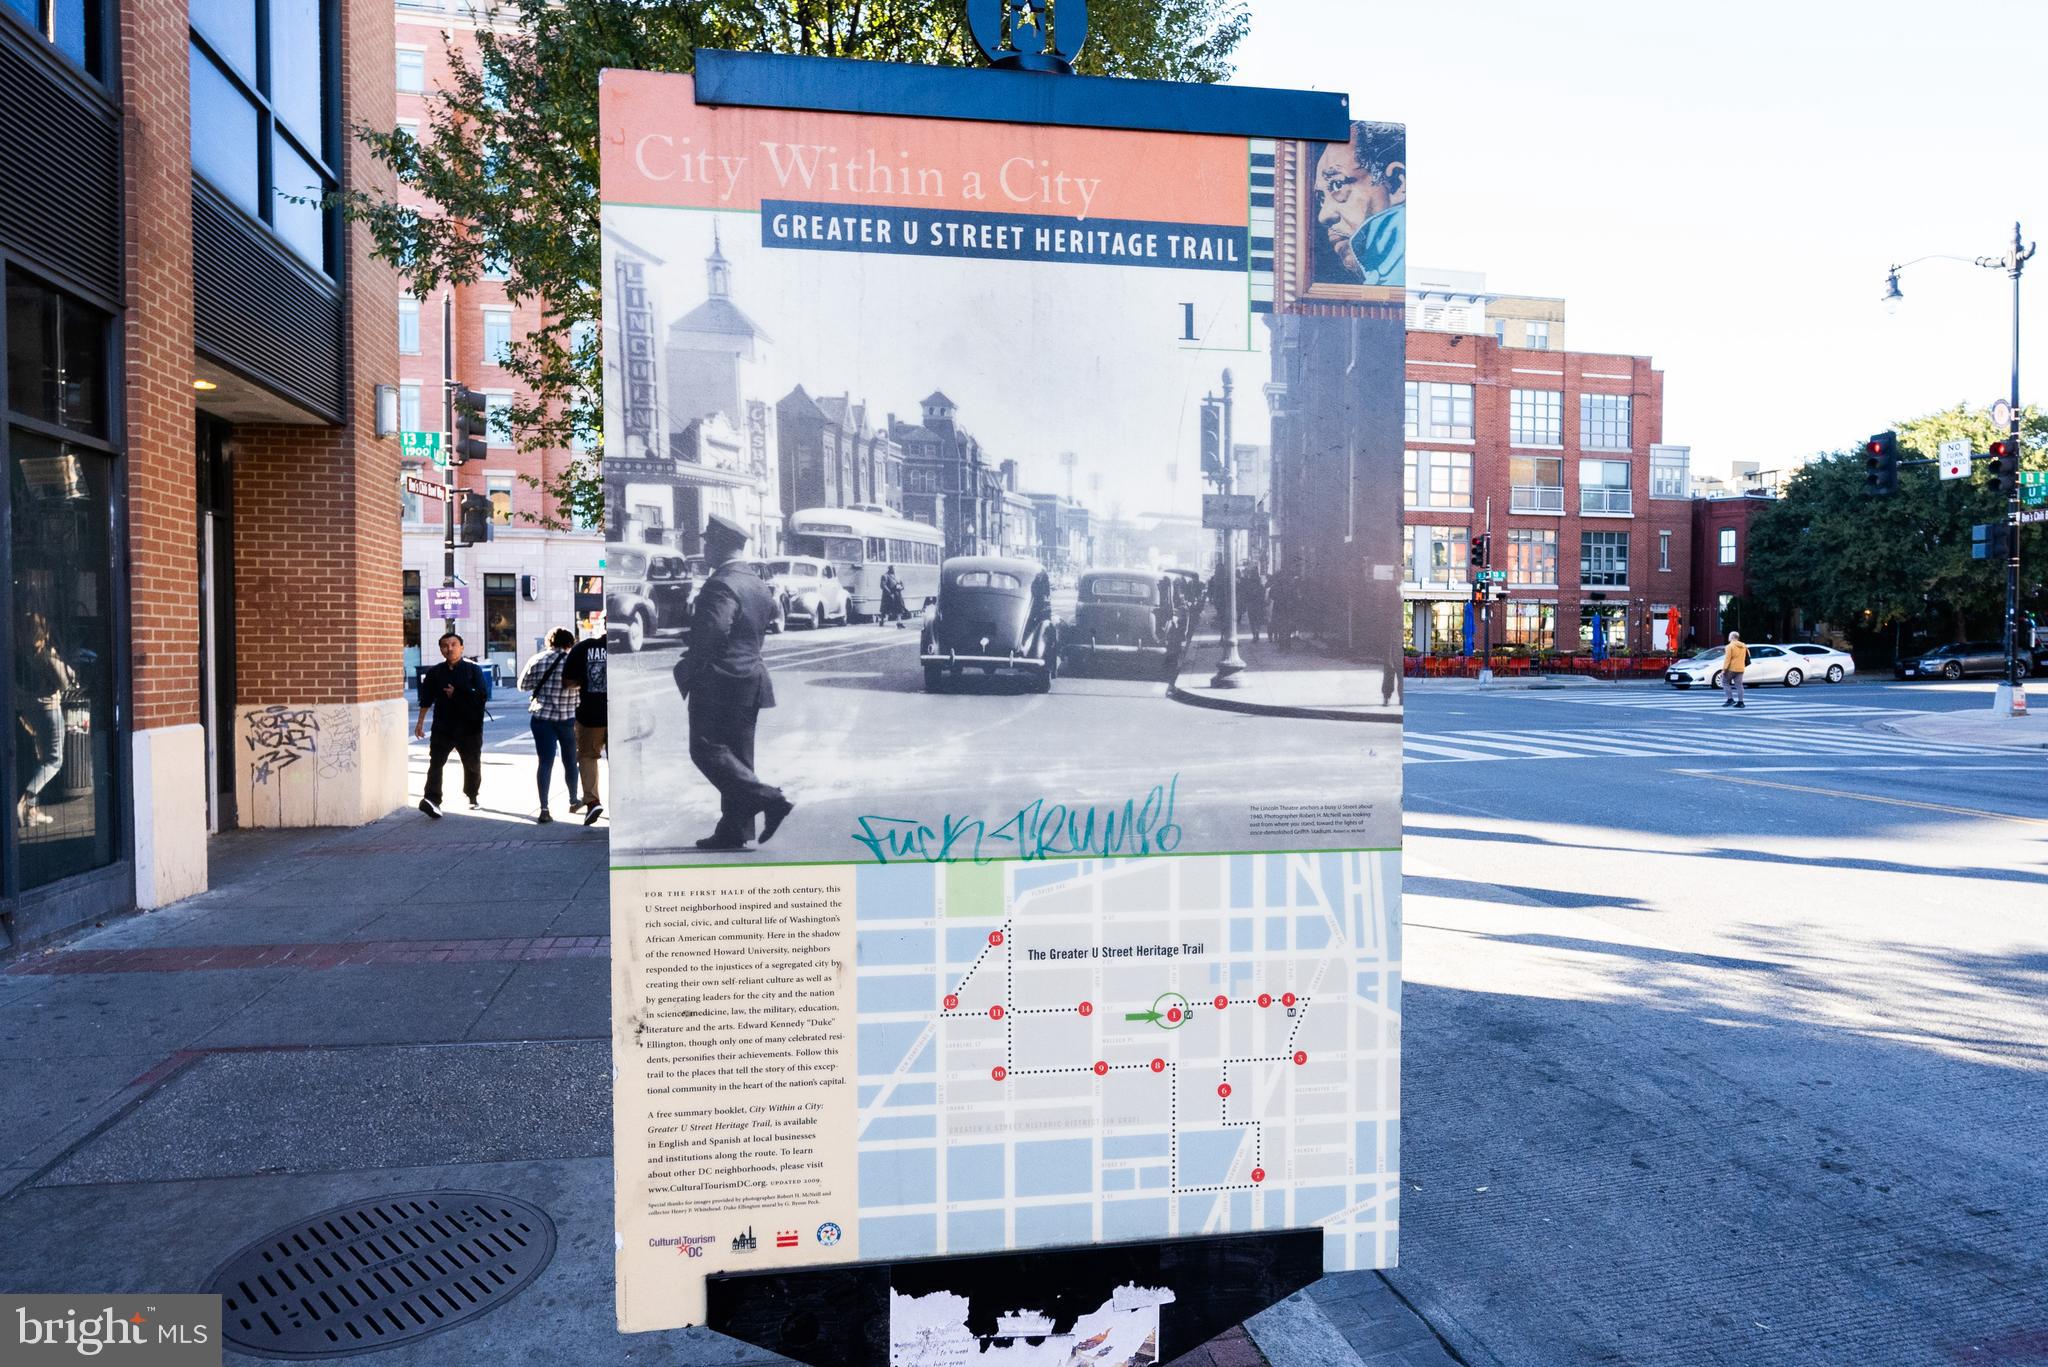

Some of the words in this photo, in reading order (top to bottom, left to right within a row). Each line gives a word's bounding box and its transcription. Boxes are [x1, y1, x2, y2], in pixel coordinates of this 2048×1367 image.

[636, 134, 748, 200] City
[760, 142, 945, 198] Within
[962, 171, 985, 200] a
[1000, 157, 1101, 220] City
[772, 214, 892, 244] GREATER
[903, 220, 918, 244] U
[930, 222, 1024, 250] STREET
[1036, 228, 1158, 257] HERITAGE
[1168, 236, 1238, 262] TRAIL
[1178, 302, 1200, 341] 1
[406, 448, 430, 456] 1900
[1948, 443, 1960, 451] NO
[2029, 487, 2036, 497] U
[747, 886, 755, 895] of
[757, 886, 770, 894] the
[772, 886, 790, 894] 20th
[792, 886, 824, 895] century,
[826, 884, 840, 893] this
[645, 904, 652, 912] U
[654, 903, 677, 912] Street
[680, 902, 737, 913] neighborhood
[739, 901, 771, 911] inspired
[773, 901, 788, 909] and
[790, 900, 827, 908] sustained
[829, 899, 842, 908] the
[645, 919, 661, 927] rich
[663, 918, 688, 927] social,
[690, 918, 711, 927] civic,
[714, 917, 729, 926] and
[731, 916, 762, 925] cultural
[764, 916, 777, 924] life
[778, 916, 787, 924] of
[789, 914, 840, 925] Washington's
[645, 934, 675, 943] African
[678, 932, 716, 942] American
[718, 932, 764, 942] community.
[767, 930, 785, 939] Here
[797, 930, 809, 938] the
[812, 929, 840, 938] shadow
[645, 949, 653, 958] of
[656, 949, 668, 957] the
[671, 948, 710, 957] renowned
[713, 947, 745, 956] Howard
[747, 945, 789, 956] University,
[791, 944, 830, 955] neighbors
[1028, 949, 1046, 960] The
[1050, 949, 1088, 959] Greater
[1092, 948, 1098, 958] U
[1102, 947, 1132, 957] Street
[1136, 945, 1179, 957] Heritage
[1182, 943, 1204, 954] Trail
[648, 1110, 654, 1118] A
[656, 1109, 672, 1118] free
[673, 1109, 712, 1119] summary
[714, 1105, 747, 1115] booklet,
[748, 1104, 766, 1115] City
[768, 1103, 795, 1112] Within
[804, 1102, 823, 1112] City:
[648, 1124, 678, 1133] Greater
[681, 1123, 687, 1132] U
[690, 1122, 712, 1131] Street
[715, 1120, 749, 1131] Heritage
[752, 1119, 772, 1128] Trail,
[783, 1117, 818, 1126] available
[658, 1138, 689, 1149] English
[691, 1137, 706, 1146] and
[709, 1135, 740, 1146] Spanish
[753, 1134, 772, 1142] local
[774, 1131, 816, 1141] businesses
[647, 1154, 663, 1163] and
[665, 1152, 712, 1162] institutions
[714, 1150, 737, 1161] along
[739, 1149, 752, 1158] the
[754, 1148, 777, 1157] route.
[780, 1147, 790, 1156] To
[792, 1146, 813, 1155] learn
[647, 1169, 671, 1178] about
[673, 1167, 696, 1177] other
[698, 1166, 712, 1175] DC
[714, 1163, 778, 1176] neighborhoods,
[780, 1161, 804, 1172] please
[806, 1161, 823, 1169] visit
[648, 1178, 768, 1194] www.CulturalTourismDC.org.
[649, 1236, 681, 1247] Cultural
[682, 1235, 716, 1244] Tourism
[688, 1246, 703, 1258] DC
